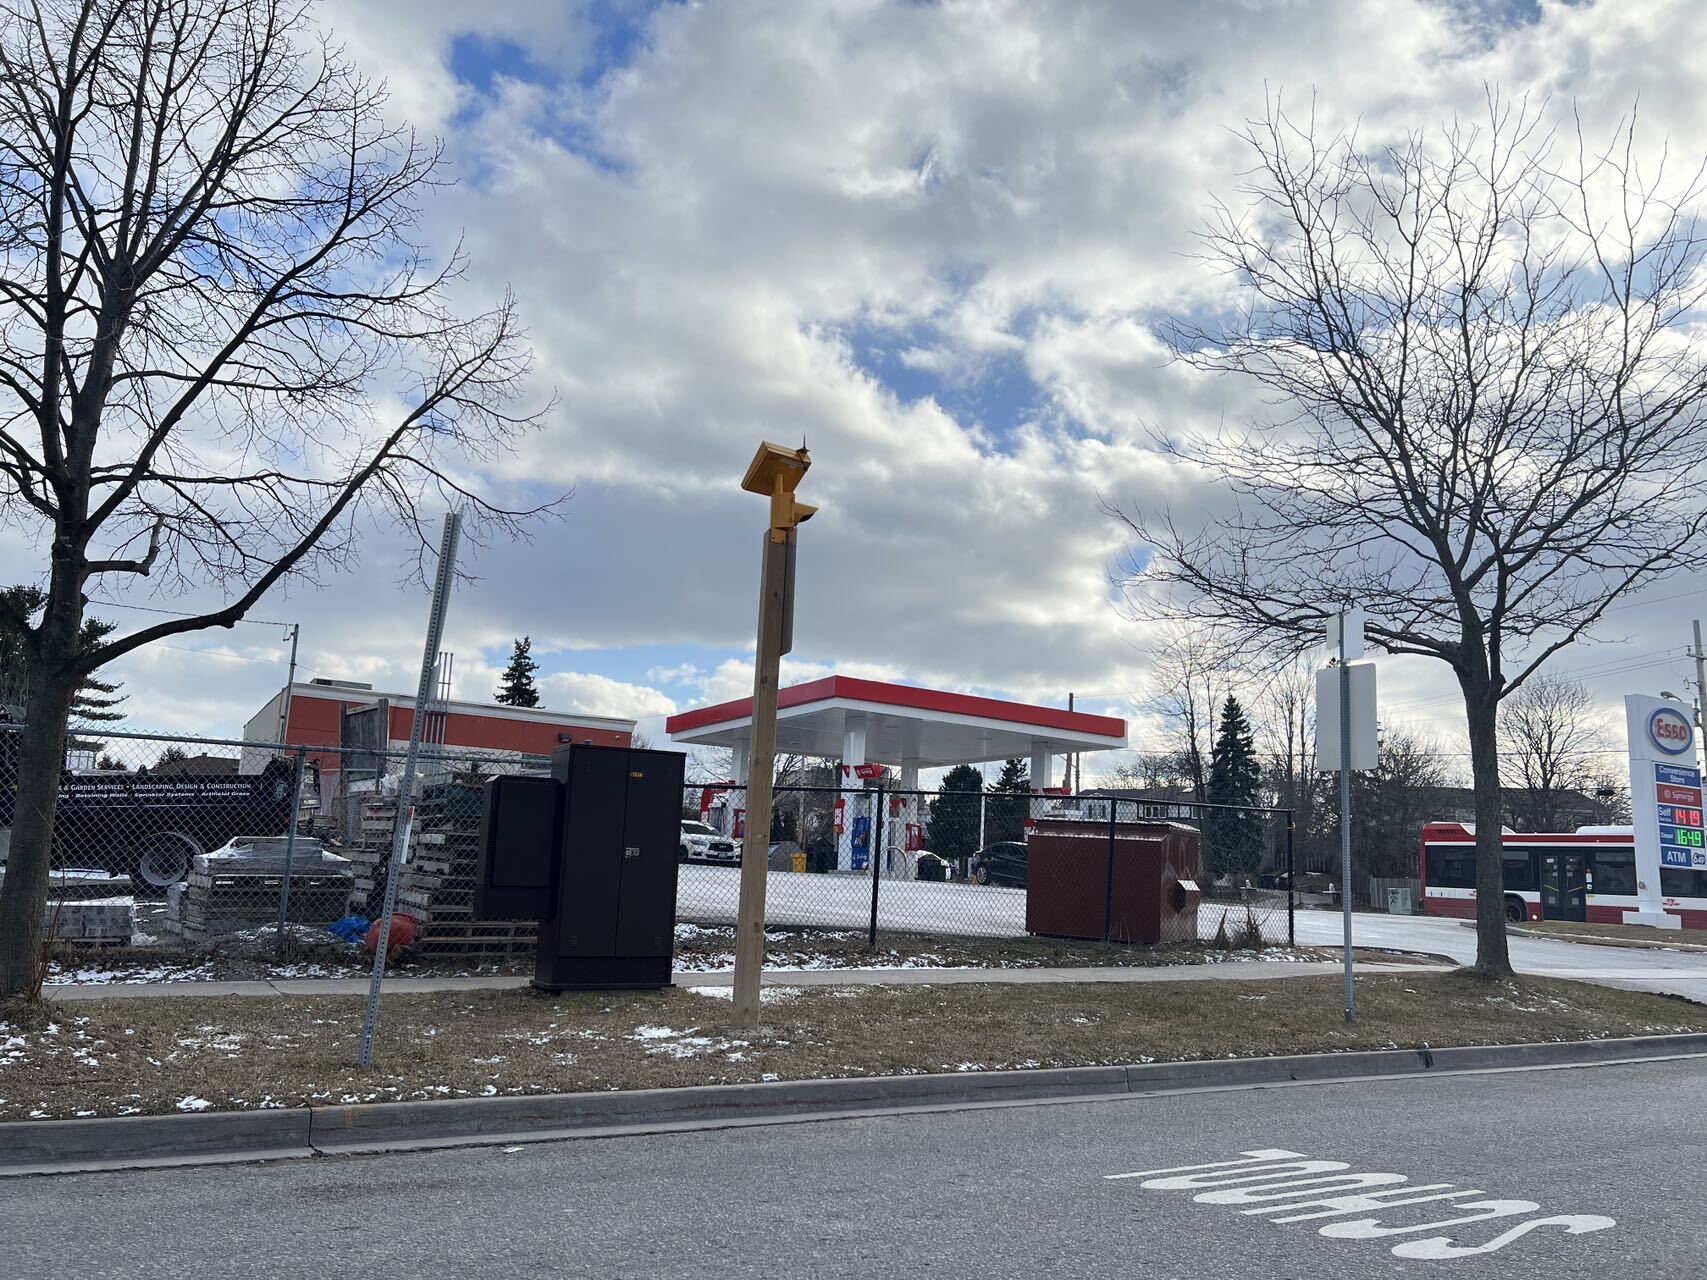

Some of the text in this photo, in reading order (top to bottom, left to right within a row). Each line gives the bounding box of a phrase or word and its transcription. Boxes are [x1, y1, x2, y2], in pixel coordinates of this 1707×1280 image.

[1659, 766, 1695, 778] Convenience
[1670, 775, 1685, 784] Store
[1667, 851, 1687, 863] ATM
[1103, 1149, 1616, 1259] SCHOOL
